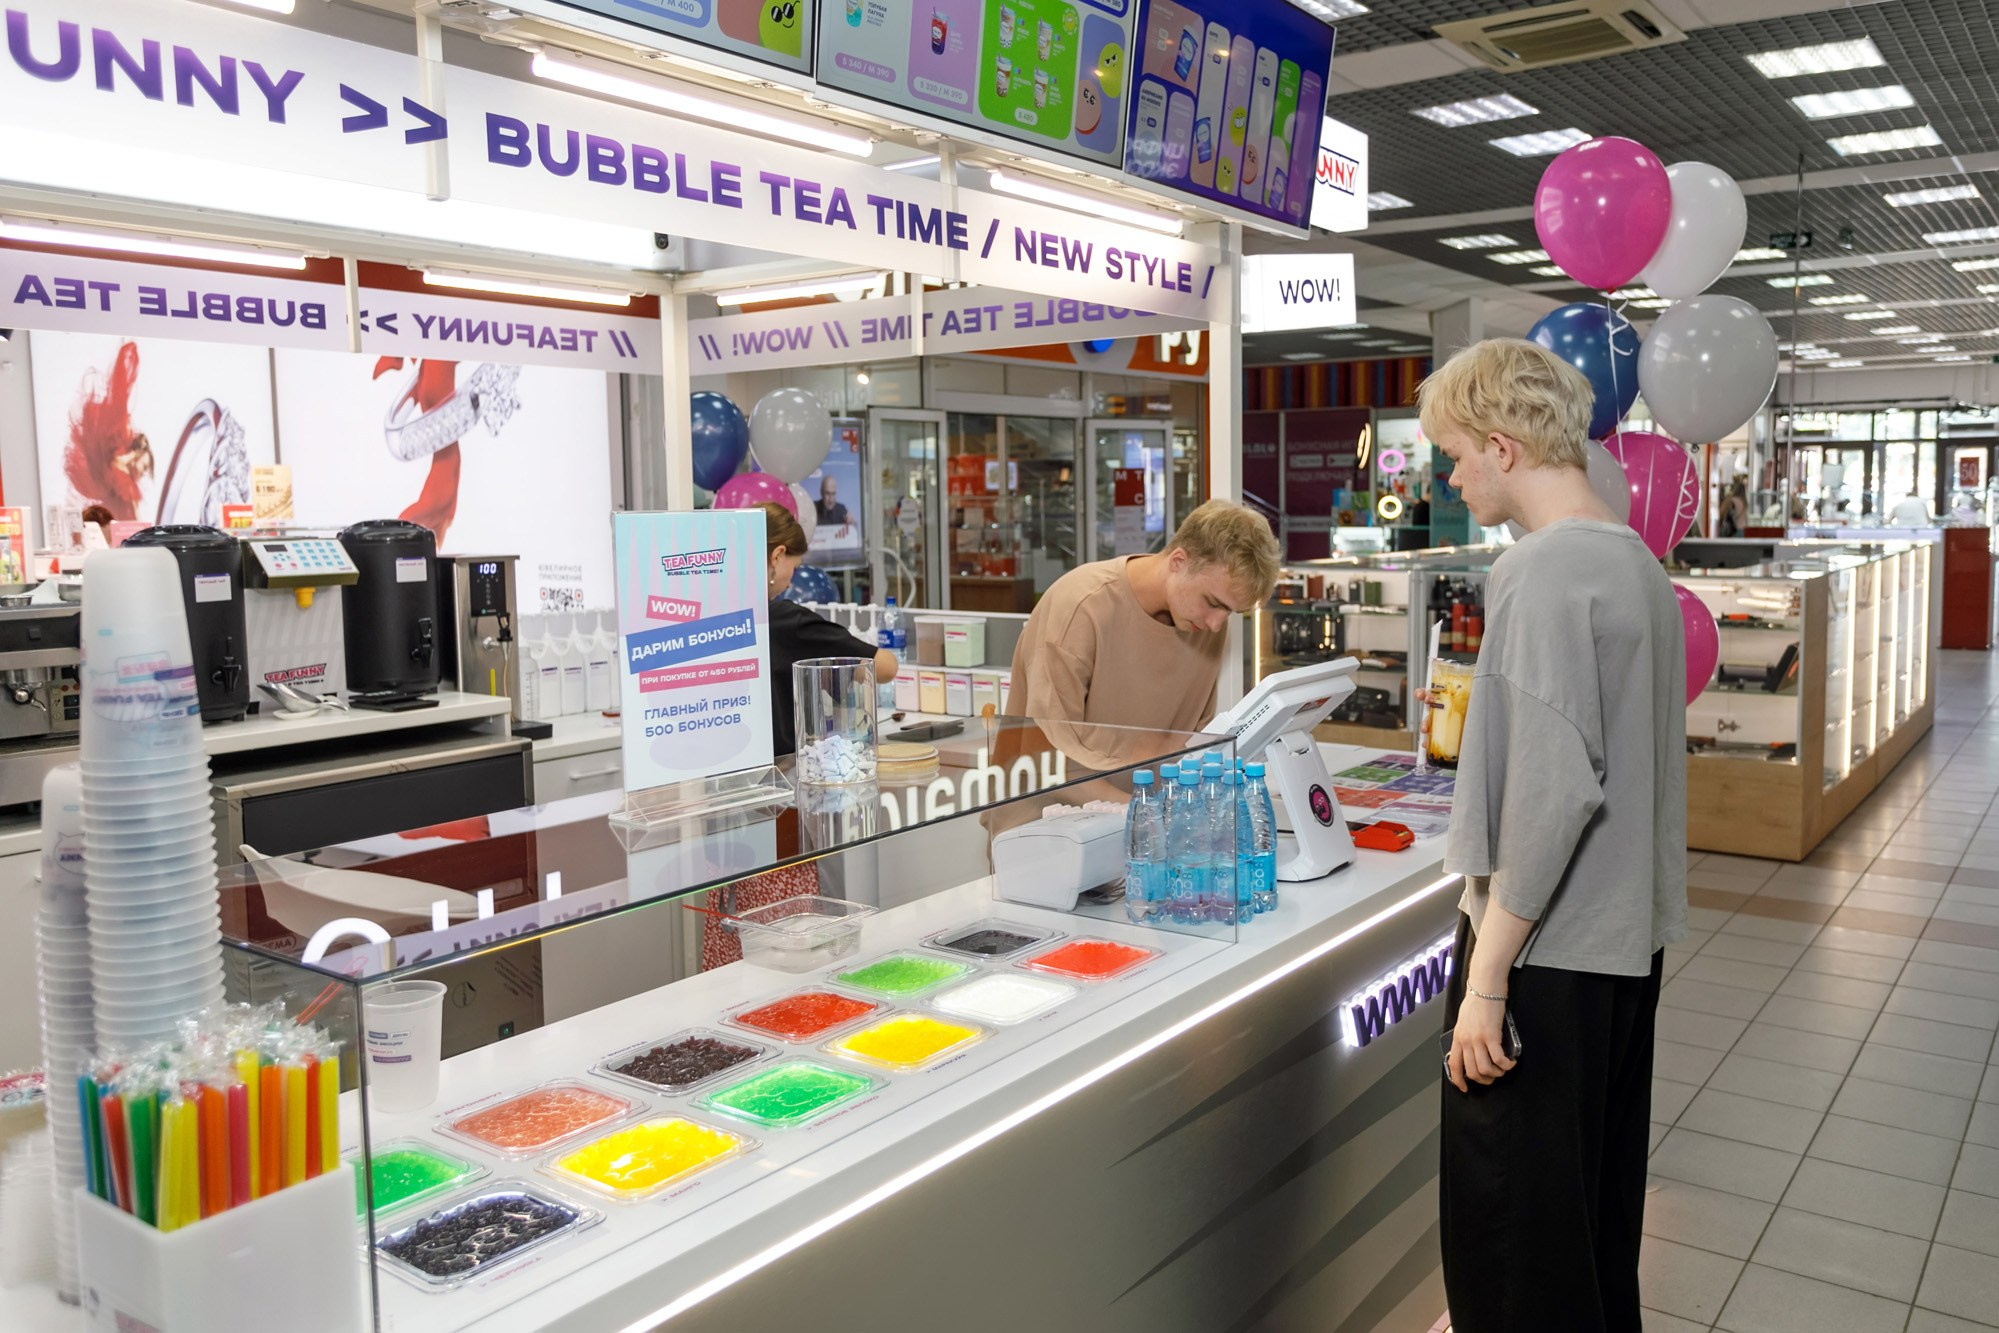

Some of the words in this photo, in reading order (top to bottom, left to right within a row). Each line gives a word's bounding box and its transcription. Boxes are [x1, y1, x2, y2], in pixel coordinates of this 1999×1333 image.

[876, 68, 890, 78] 390
[5, 8, 306, 125] UNNY
[485, 111, 744, 210] BUBBLE
[760, 174, 857, 230] TEA
[867, 197, 969, 251] TIME
[1014, 227, 1094, 274] NEW
[1105, 247, 1193, 294] STYLE
[1278, 279, 1341, 305] WOW!
[480, 563, 497, 574] 100
[538, 564, 582, 572] ЮВЕЛИРНОЕ
[664, 556, 685, 569] TEA
[687, 550, 725, 566] FUNNY
[538, 573, 582, 582] ПРИЛОЖЕНИЕ
[651, 600, 696, 618] WOW!
[632, 637, 684, 661] ДАРИМ
[688, 618, 752, 646] БОНУСЫ!
[266, 672, 288, 683] TEA
[289, 666, 325, 679] FUNNY
[641, 676, 658, 685] ПРИ
[660, 672, 696, 682] ПОКУПКЕ
[698, 670, 708, 678] ОТ
[710, 668, 726, 676] 450
[728, 664, 756, 674] РУБЛЕЙ
[644, 698, 708, 720] ГЛАВНЫЙ
[713, 696, 750, 710] ПРИЗ!
[646, 724, 674, 738] 500
[678, 713, 742, 732] БОНУСОВ
